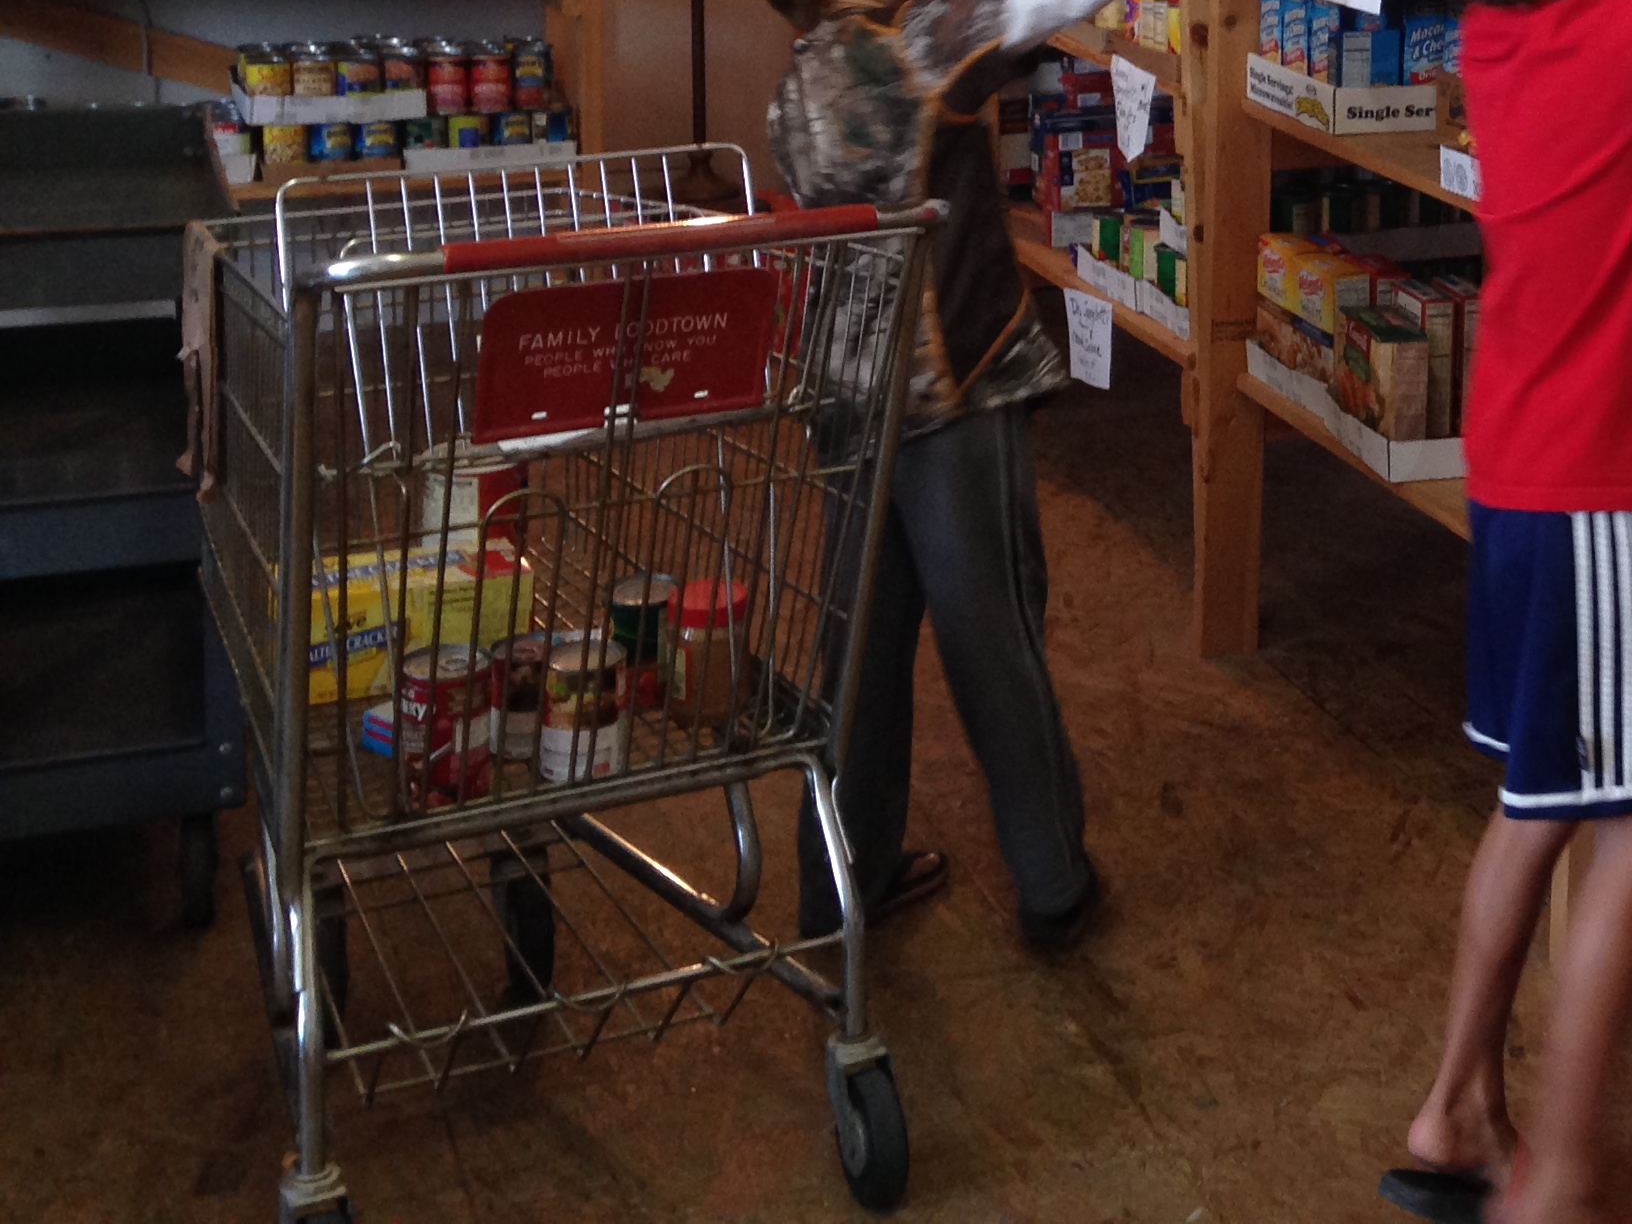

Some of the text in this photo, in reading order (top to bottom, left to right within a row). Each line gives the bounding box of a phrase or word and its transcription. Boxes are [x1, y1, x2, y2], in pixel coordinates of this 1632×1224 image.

[1412, 46, 1420, 59] &
[1347, 106, 1400, 121] Single
[518, 326, 600, 351] FAMILY
[524, 334, 717, 366] PEOPLE YOU
[543, 350, 692, 378] PEOPLE CARE
